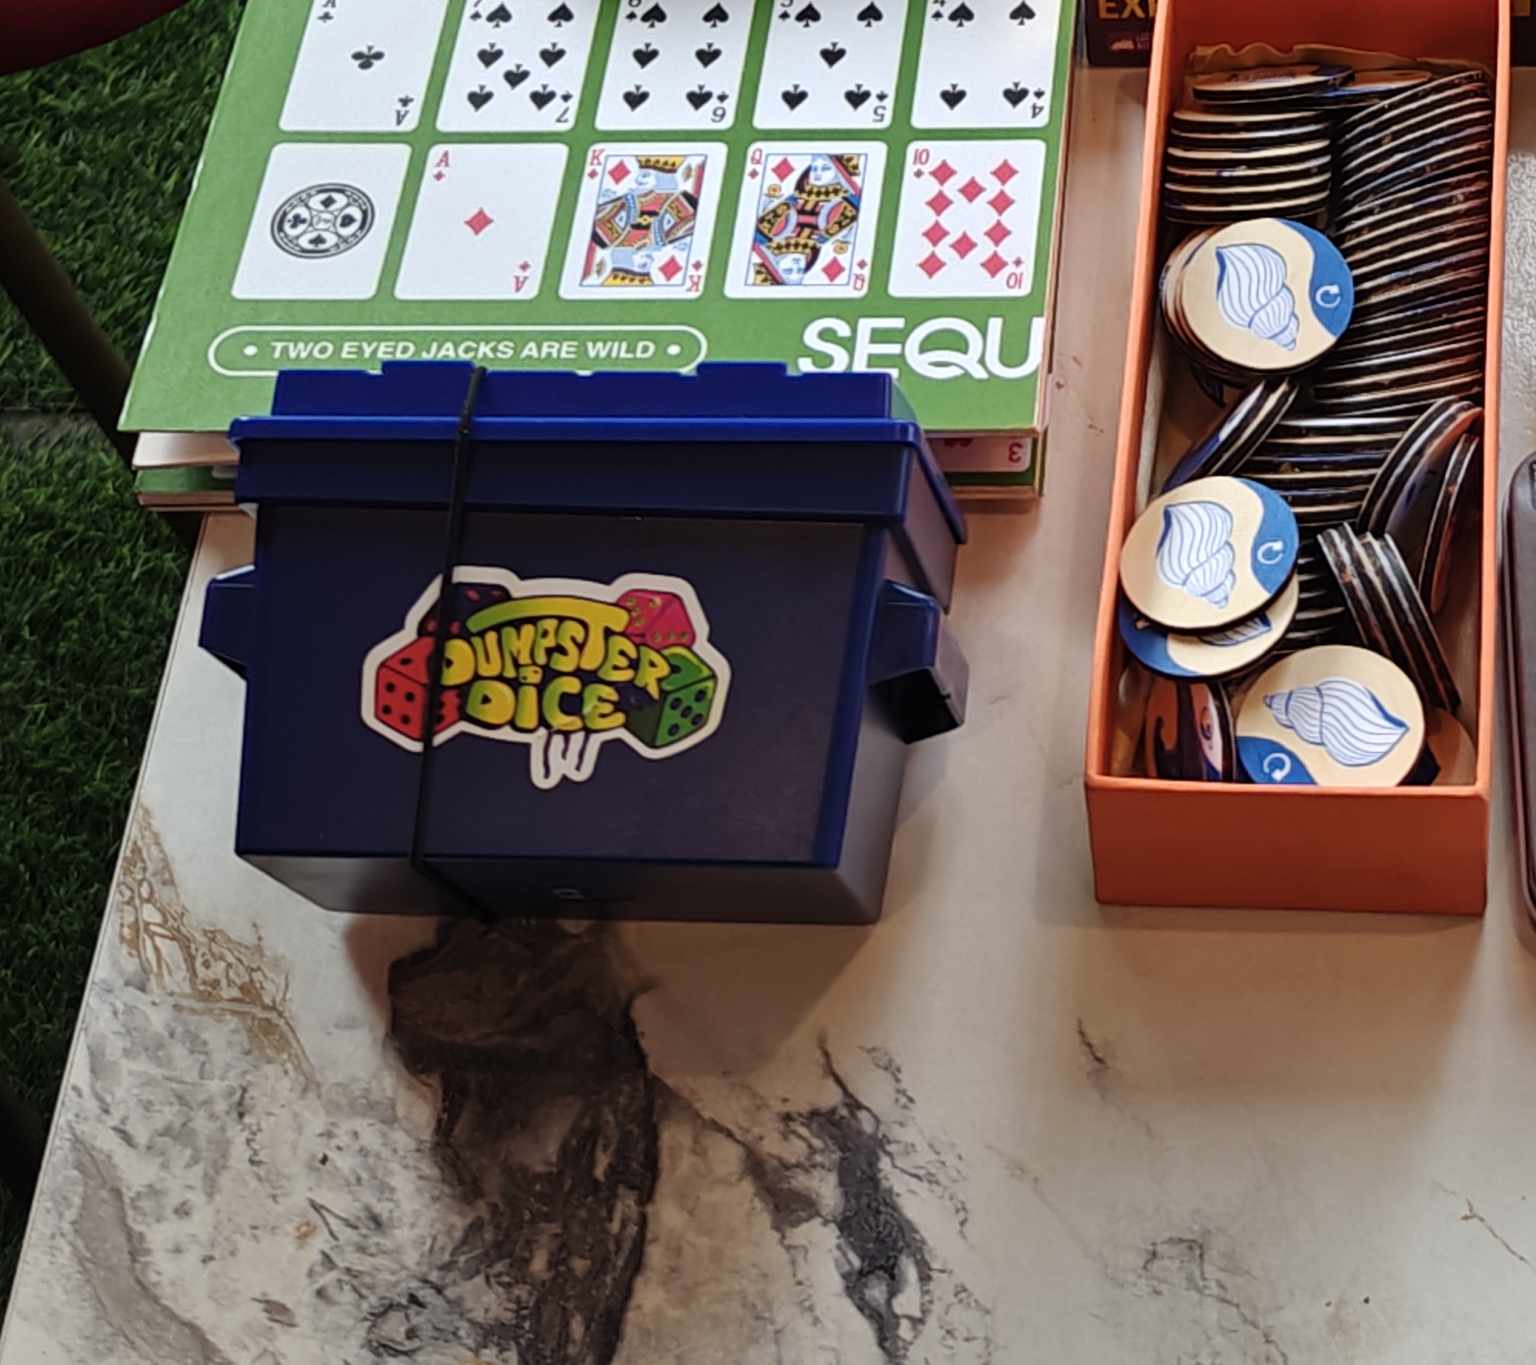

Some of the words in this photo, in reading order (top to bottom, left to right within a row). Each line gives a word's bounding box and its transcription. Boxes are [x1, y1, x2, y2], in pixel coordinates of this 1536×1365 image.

[912, 148, 931, 166] 10
[270, 340, 335, 360] TWO
[339, 340, 416, 360] EYED
[420, 340, 516, 360] JACKS
[519, 340, 579, 360] ARE
[585, 340, 656, 360] WILD
[796, 316, 1046, 380] SEQU
[1007, 441, 1024, 463] 3
[439, 595, 672, 701] DUMPSTER
[465, 664, 628, 732] DICE
